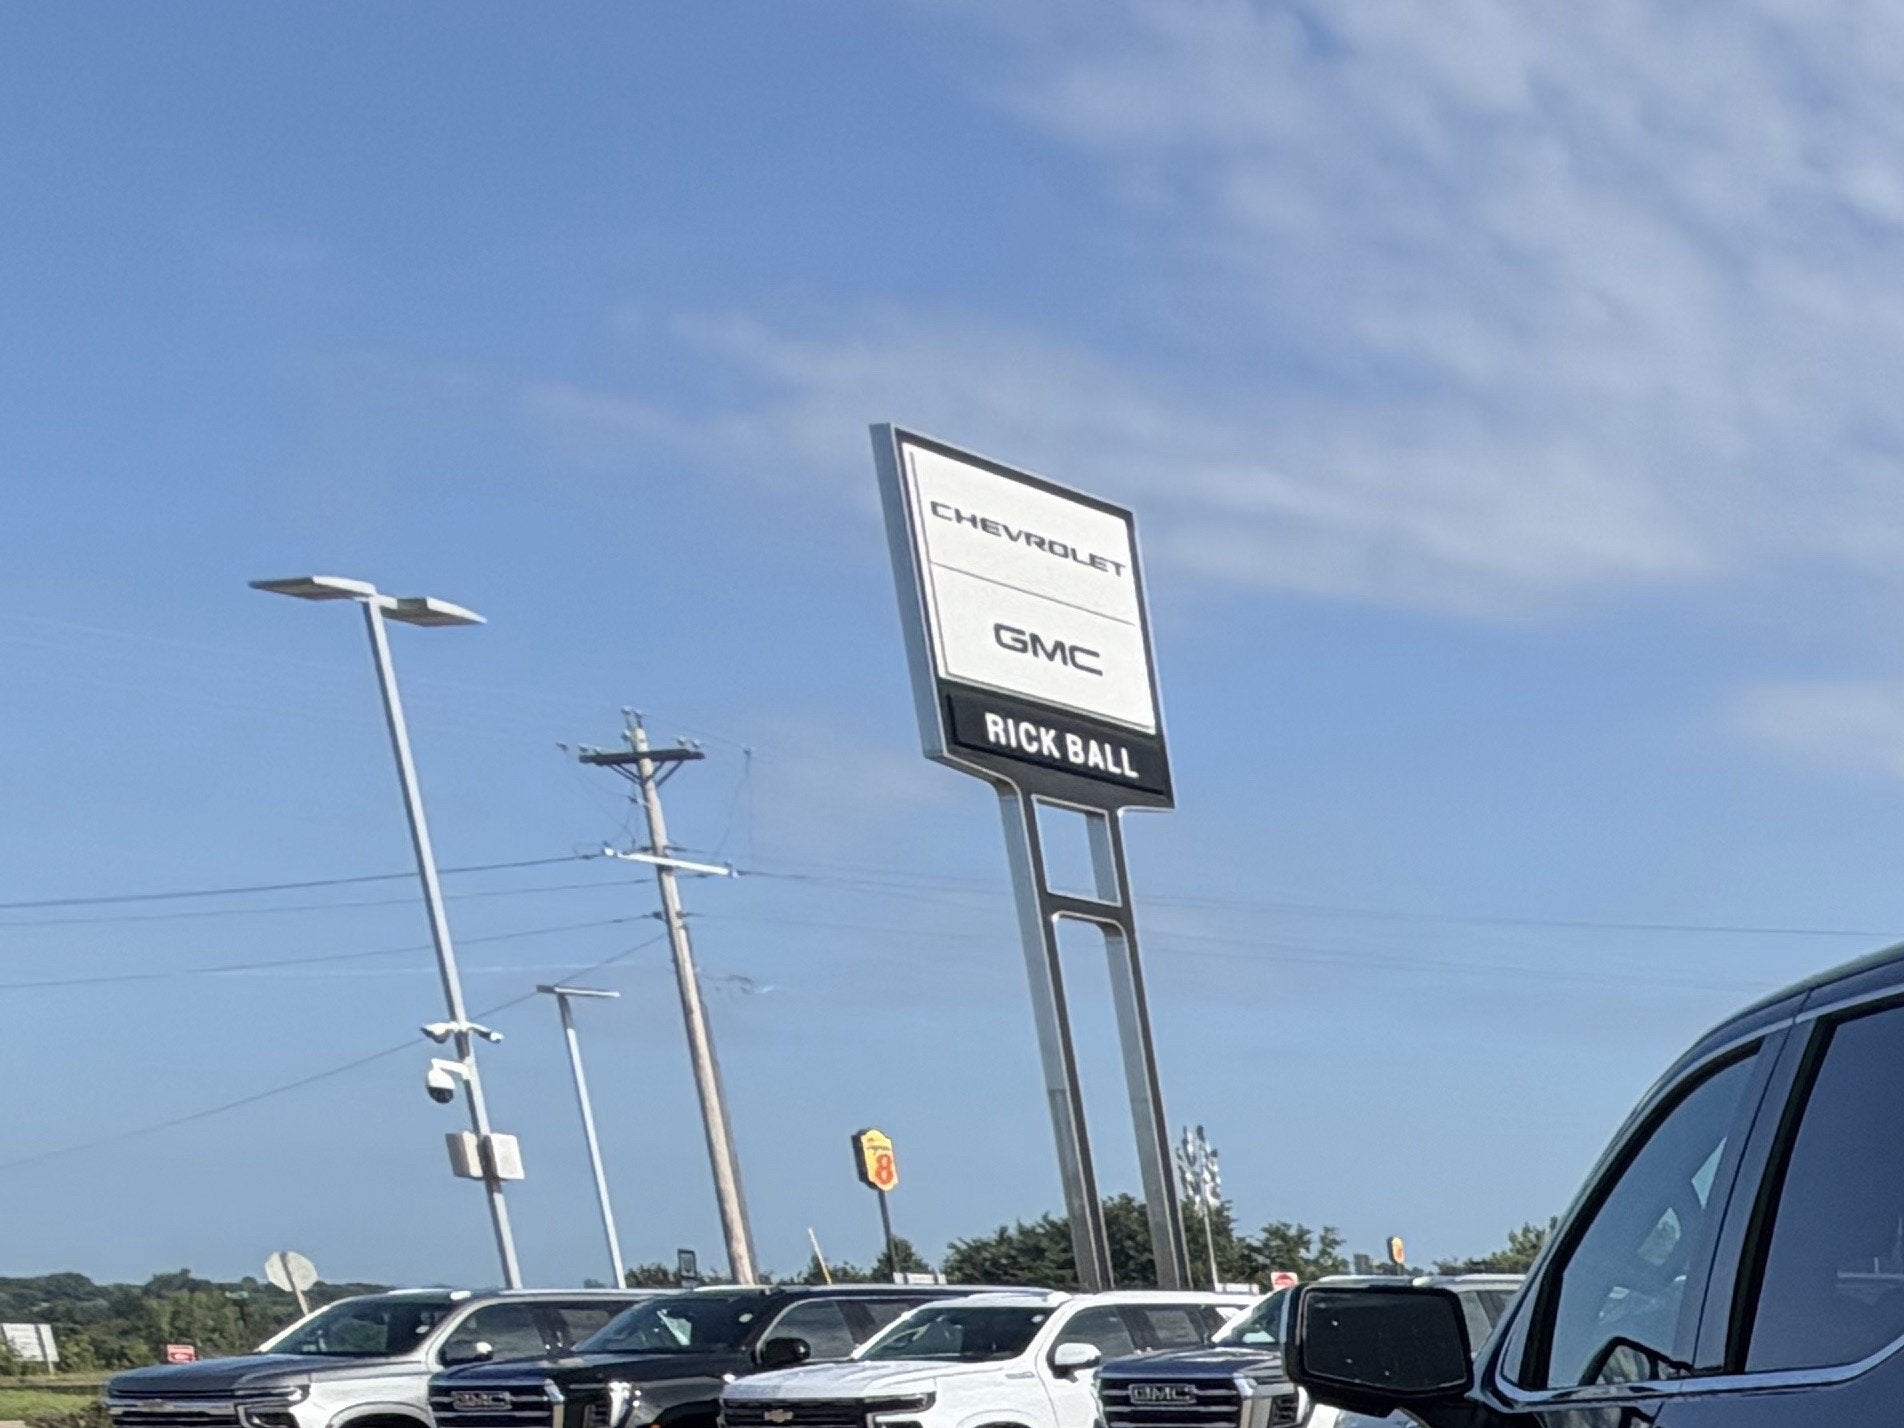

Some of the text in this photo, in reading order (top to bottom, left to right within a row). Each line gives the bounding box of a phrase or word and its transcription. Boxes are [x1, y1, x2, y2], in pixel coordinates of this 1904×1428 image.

[930, 501, 1127, 577] CHEVROLET
[993, 622, 1104, 677] GMC
[984, 711, 1140, 778] RICK BALL
[875, 1153, 894, 1185] 8
